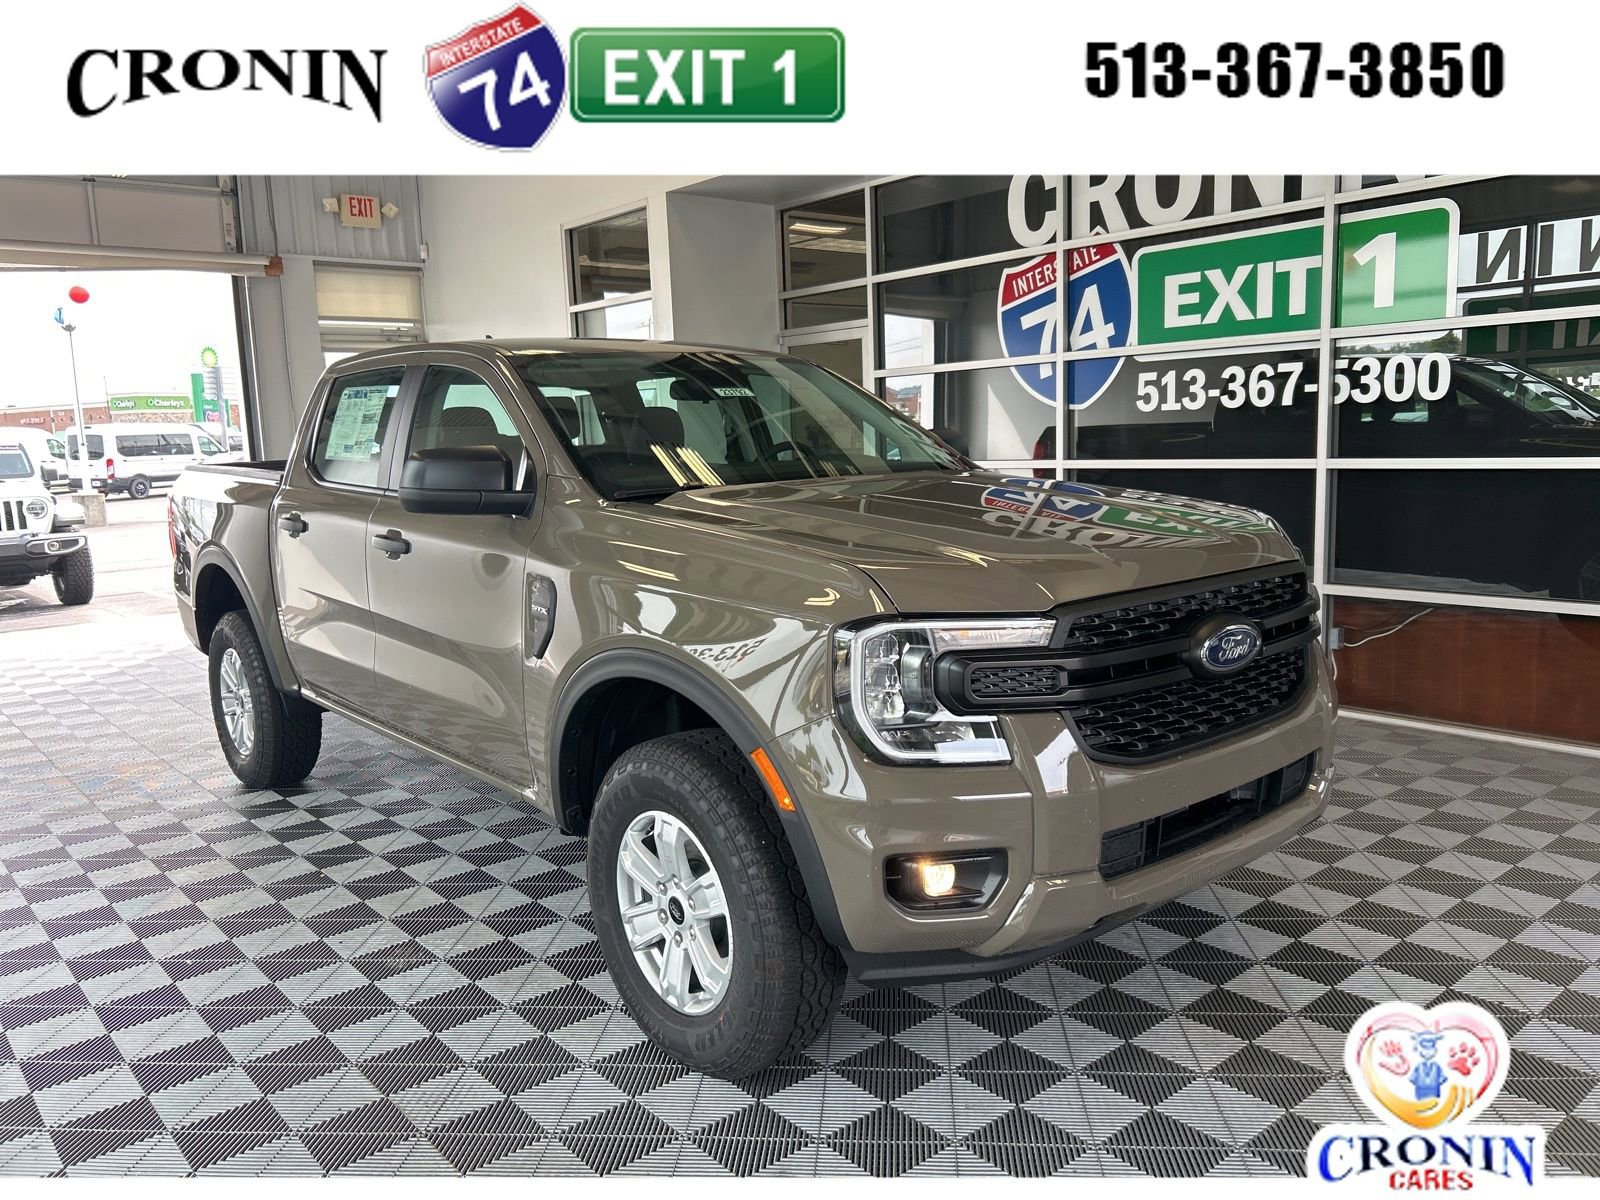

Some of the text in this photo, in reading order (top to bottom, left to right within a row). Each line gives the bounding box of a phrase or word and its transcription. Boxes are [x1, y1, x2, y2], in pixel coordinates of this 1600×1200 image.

[348, 196, 374, 218] EXIT
[1007, 174, 1432, 248] CRO
[1012, 245, 1101, 298] INTERATE
[1164, 231, 1397, 328] EXIT 1
[1020, 283, 1116, 380] 74
[1136, 352, 1452, 412] 513-367-5300
[1218, 634, 1251, 663] Ford
